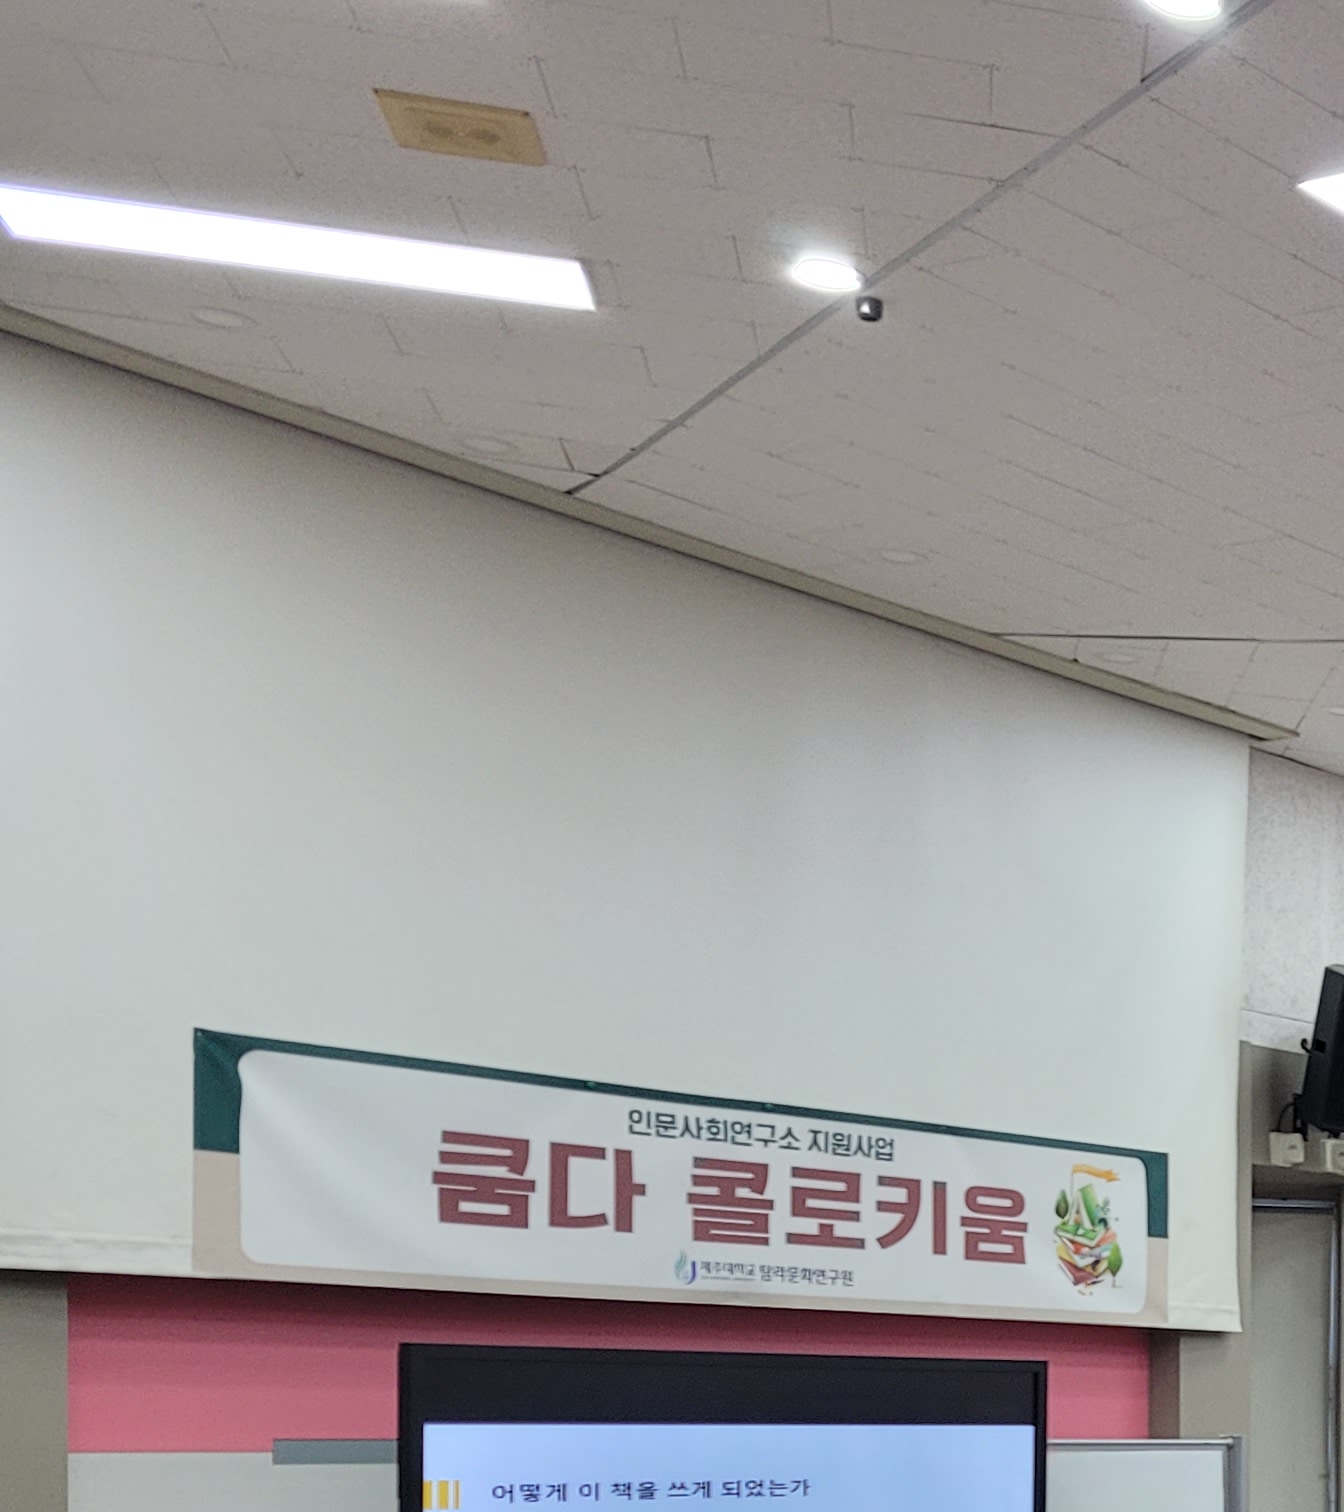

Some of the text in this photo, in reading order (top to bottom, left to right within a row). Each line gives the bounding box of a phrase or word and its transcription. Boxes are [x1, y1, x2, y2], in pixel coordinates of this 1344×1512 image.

[629, 1109, 894, 1162] 인문사회연구소 지원사업
[432, 1130, 1028, 1265] 쿰다 콜로키움
[759, 1264, 855, 1287] 탐라문화연구원
[492, 1478, 811, 1503] 어떻게 이 책을 쓰게 되었는가
